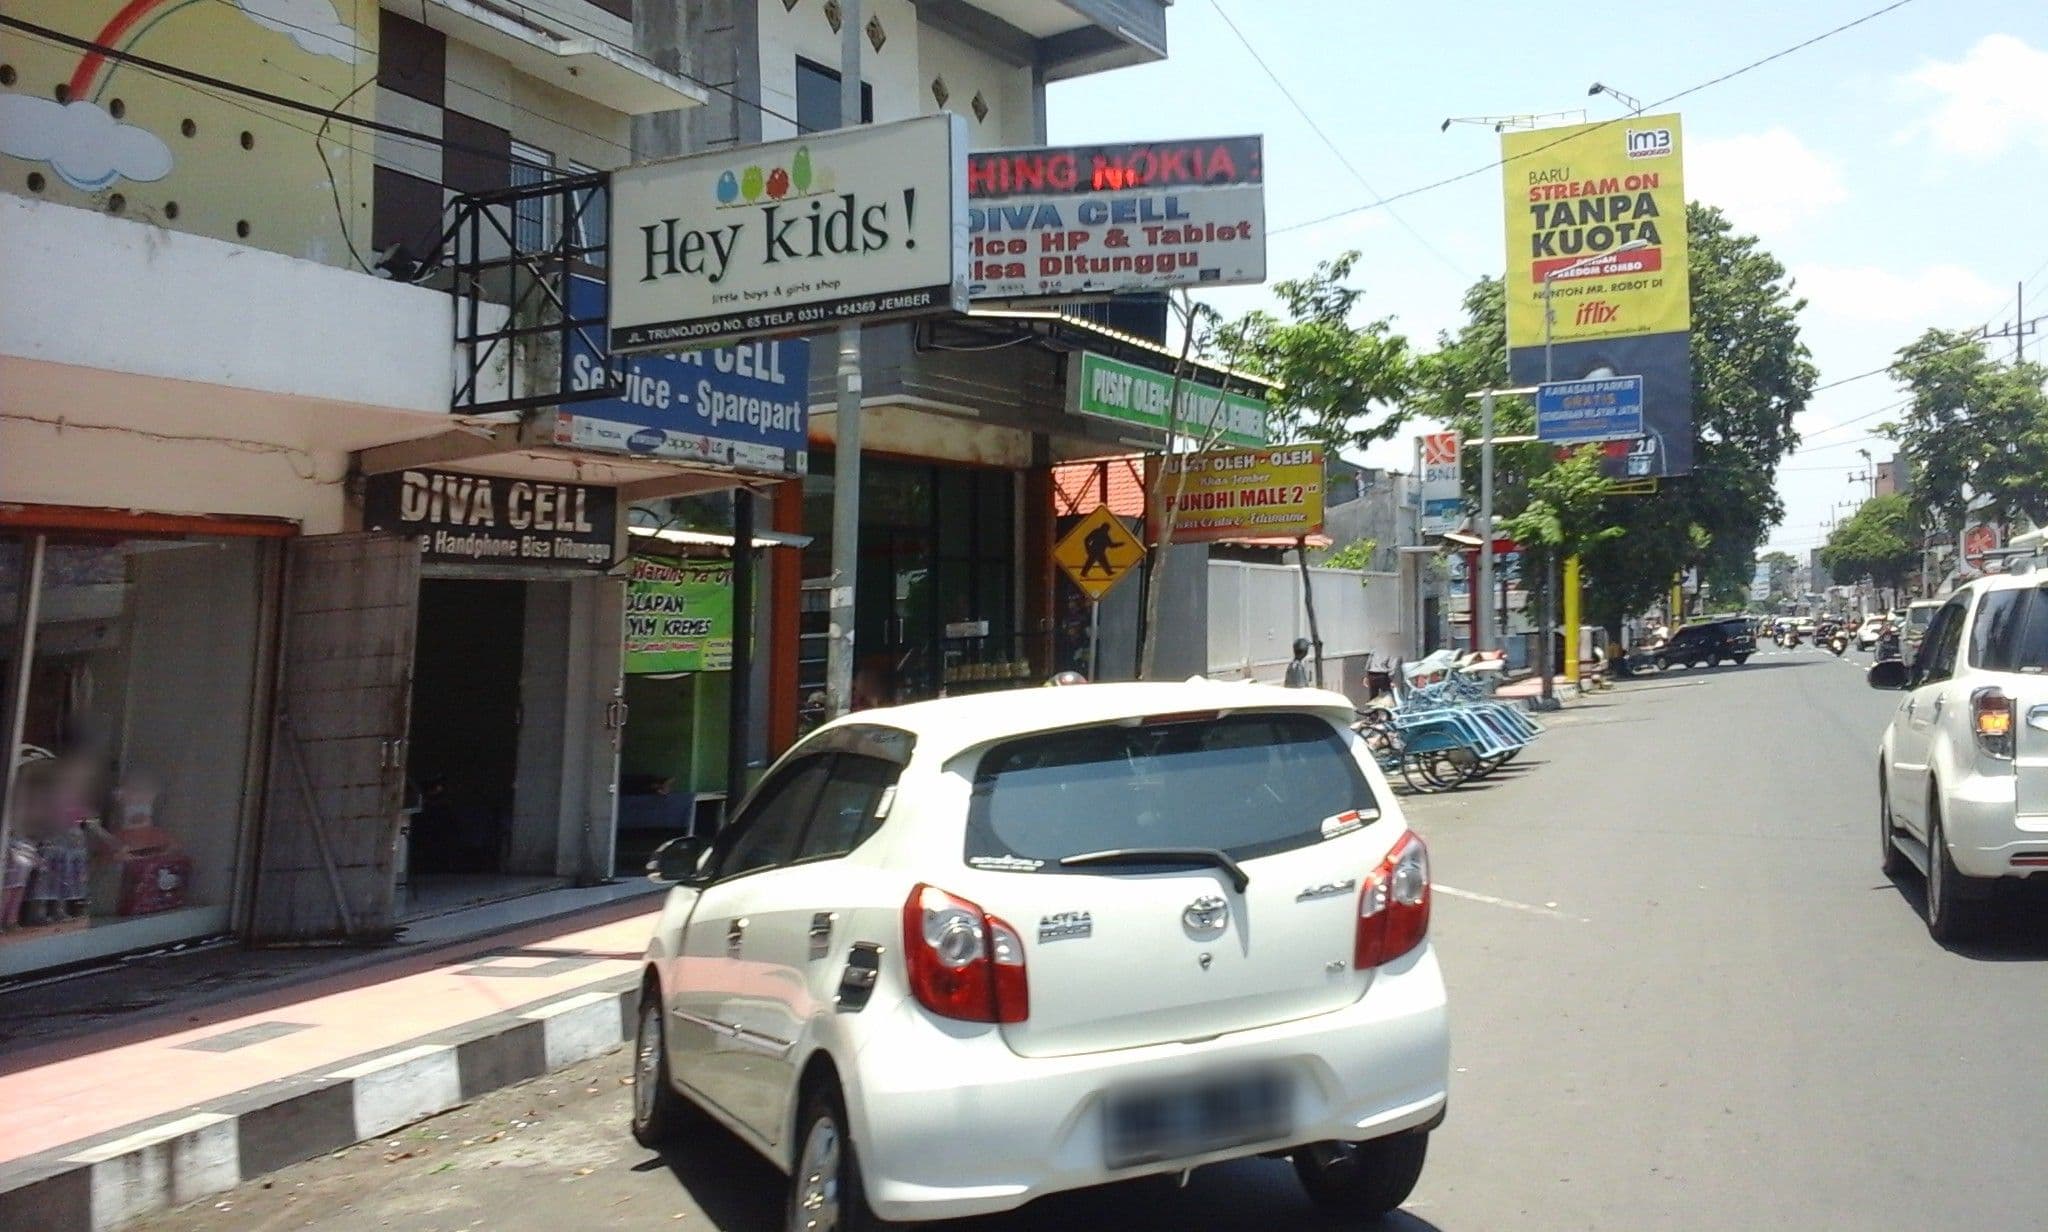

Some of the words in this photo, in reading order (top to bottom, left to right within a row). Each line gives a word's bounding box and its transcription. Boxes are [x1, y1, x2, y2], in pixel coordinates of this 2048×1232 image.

[1092, 145, 1237, 191] NOKIA
[1529, 167, 1570, 185] BARU
[1529, 178, 1620, 202] STREAM
[1625, 172, 1659, 191] ON
[1078, 197, 1191, 226] CELL
[1530, 192, 1660, 230] TANPA
[640, 217, 744, 283] Hey
[1041, 230, 1090, 253] HP
[1104, 228, 1131, 249] &
[1142, 220, 1253, 246] Tablet
[1532, 221, 1662, 257] KUOTA
[969, 260, 1027, 281] isa
[1039, 251, 1199, 278] Ditunggu
[1603, 262, 1643, 273] COMBO
[744, 288, 769, 301] boys
[815, 278, 841, 292] shop
[1533, 286, 1583, 299] NNTON
[1611, 281, 1648, 292] ROBOT
[1652, 279, 1663, 289] DI
[647, 321, 721, 341] TRUNOJOYO
[723, 317, 745, 333] NO.
[763, 311, 795, 328] TELP.
[798, 307, 825, 322] 0331
[878, 293, 930, 312] JEMBER
[1576, 301, 1620, 327] iflix
[714, 341, 786, 384] CELL
[697, 379, 801, 435] Sparepart
[1093, 368, 1133, 409] PUSAT
[1133, 378, 1165, 416] OLEH
[1214, 454, 1255, 471] OLEH
[1270, 451, 1313, 466] OLEH
[400, 471, 495, 527] DIVA
[508, 482, 593, 533] CELL
[1239, 486, 1288, 508] MALE
[435, 530, 518, 559] Handphone
[521, 535, 551, 558] Bisa
[554, 537, 611, 564] Ditunggu
[662, 619, 712, 636] KREMES
